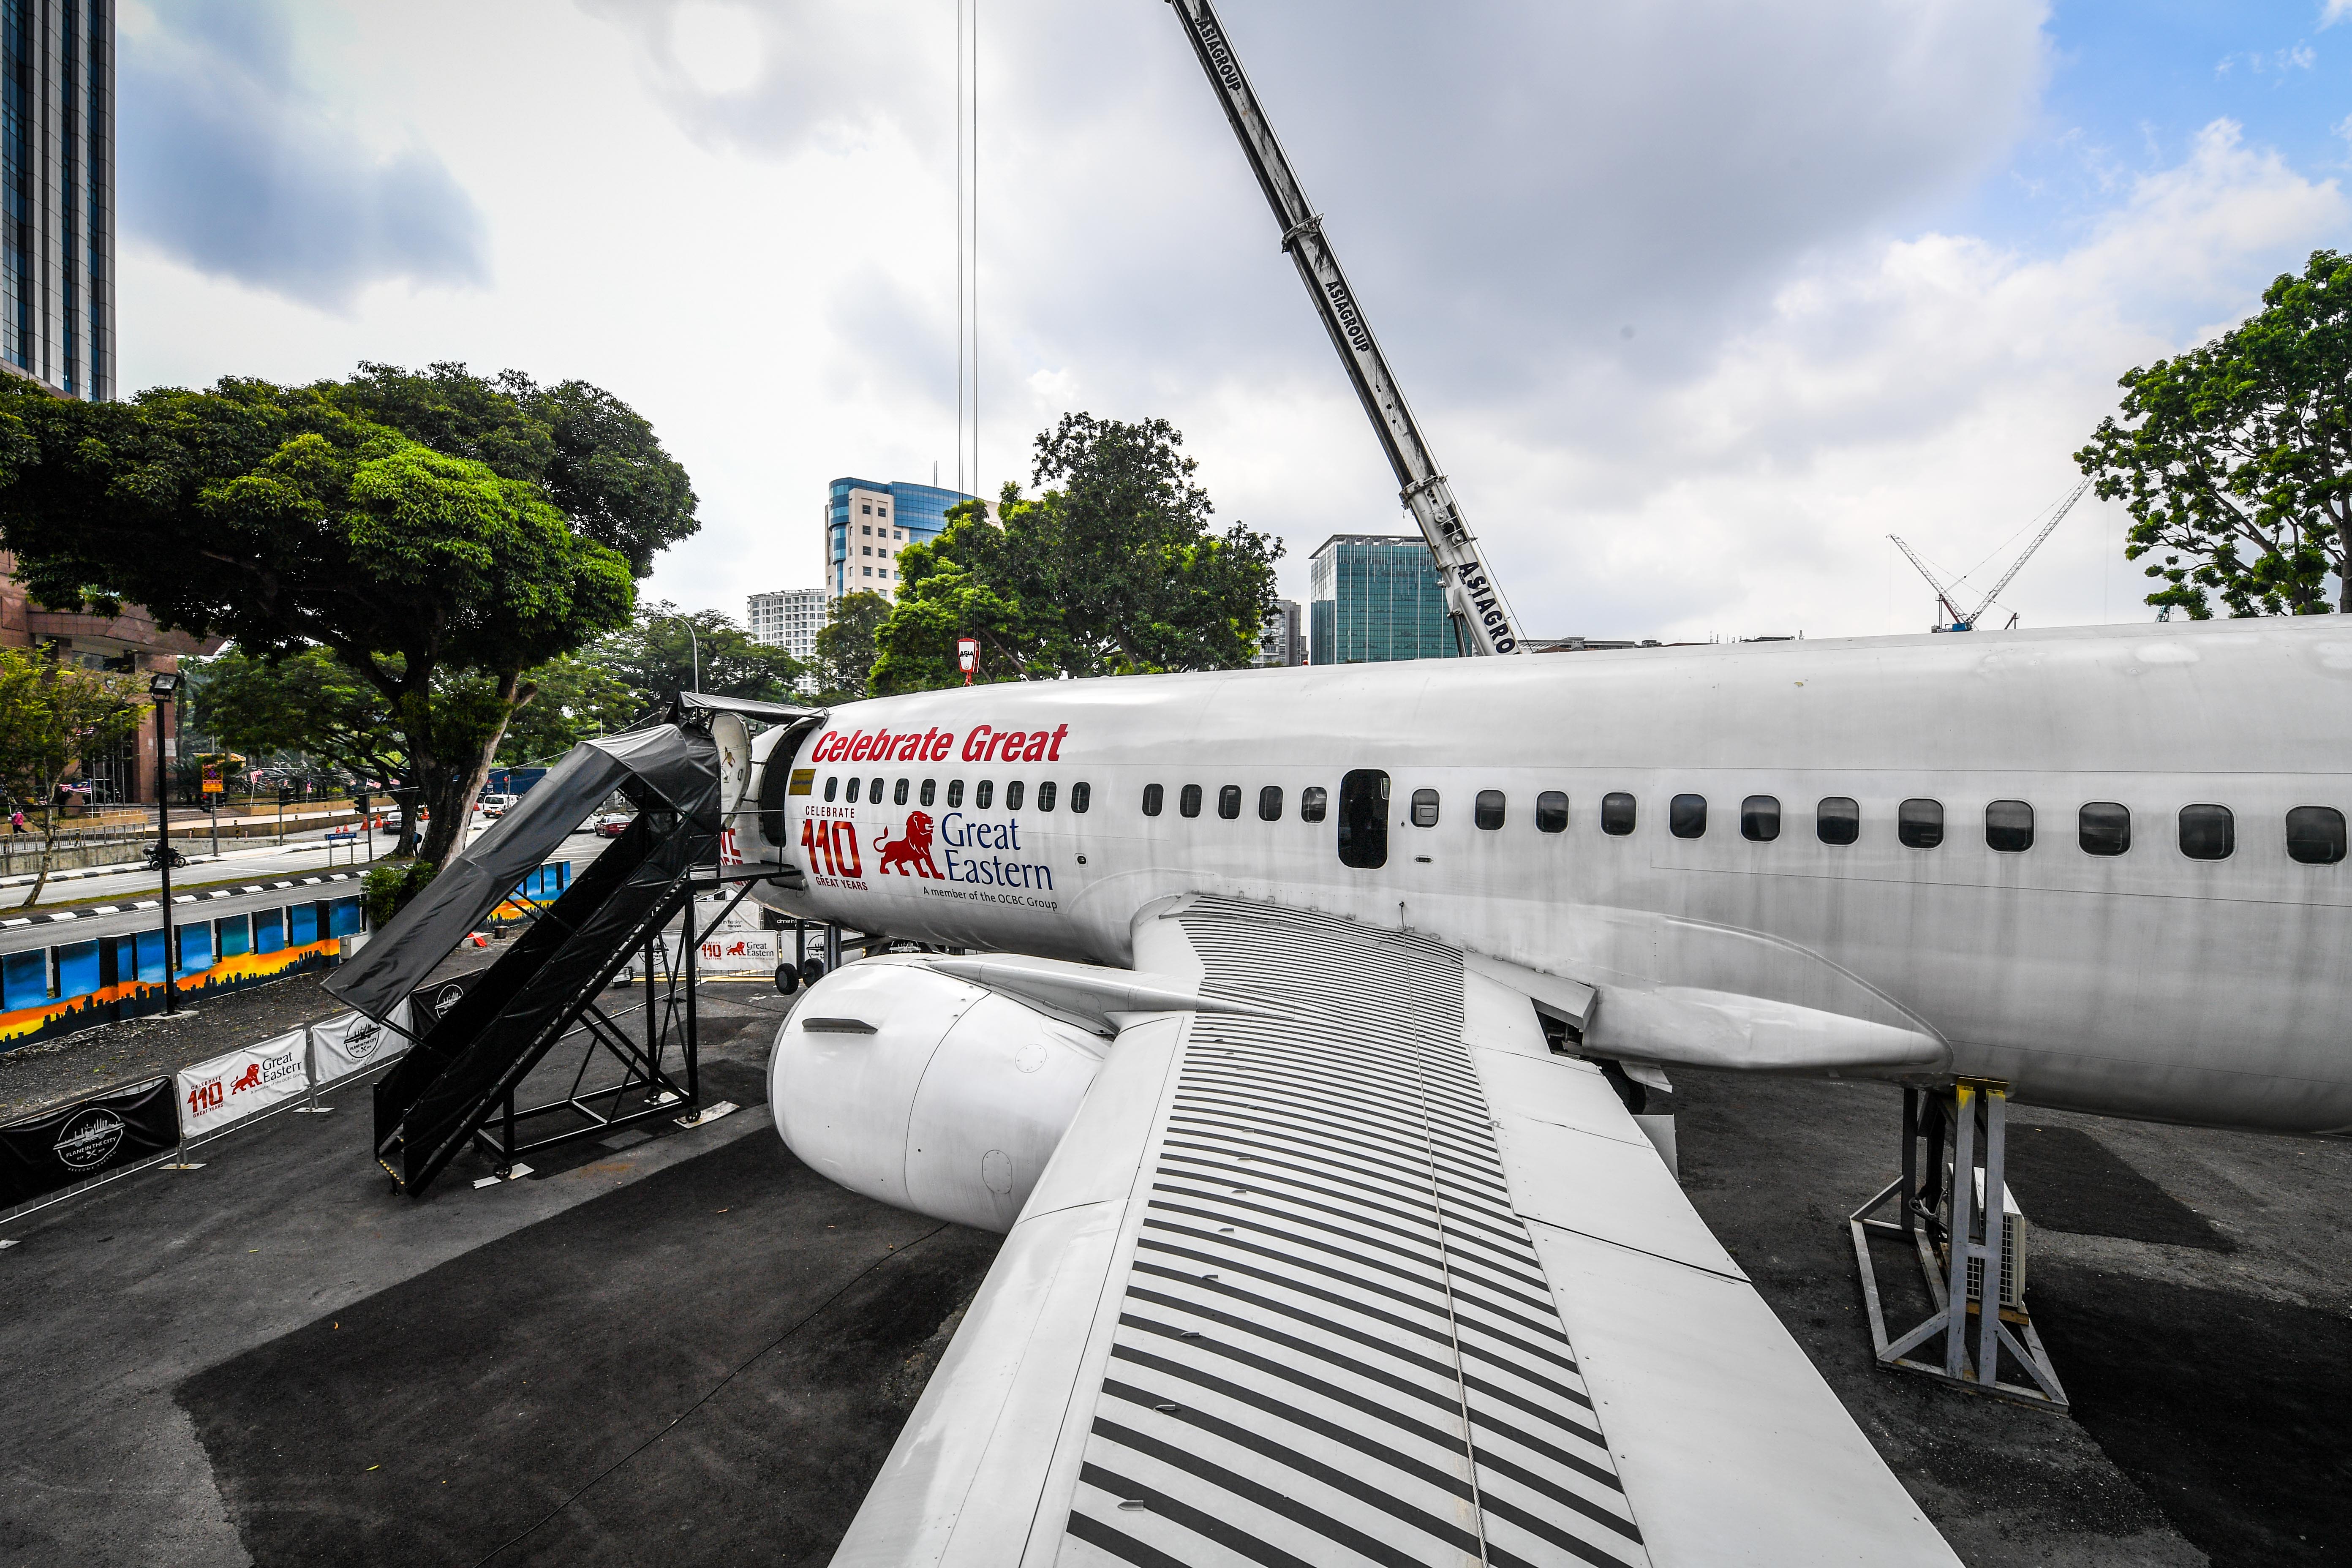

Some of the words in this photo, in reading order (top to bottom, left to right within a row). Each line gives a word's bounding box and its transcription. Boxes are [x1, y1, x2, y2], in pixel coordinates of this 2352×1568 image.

[1196, 21, 1241, 91] ASIAGROUP
[1325, 280, 1370, 352] ASIAGROUP
[1458, 561, 1520, 654] ASIAGRO
[811, 727, 954, 763] Celebrate
[961, 723, 1069, 762] Great
[805, 805, 855, 819] CELEBRATE
[941, 812, 1021, 851] Great
[801, 818, 863, 879] 110
[944, 849, 1054, 890] Eastern
[816, 876, 839, 888] GREAT
[841, 879, 868, 891] YEARS
[923, 886, 930, 895] A
[931, 888, 966, 900] member
[969, 891, 978, 901] of
[980, 892, 996, 903] the
[998, 894, 1025, 906] OCBC
[1026, 897, 1058, 912] Group
[701, 944, 721, 957] 110
[746, 941, 768, 949] Great
[262, 1051, 293, 1070] Great
[191, 1075, 222, 1090] CELEBRATE
[254, 1084, 270, 1093] member
[186, 1081, 223, 1113] 110
[193, 1108, 208, 1118] GREAT
[209, 1102, 223, 1112] YEARS
[66, 1148, 84, 1158] PLANE
[103, 1136, 117, 1144] CITY
